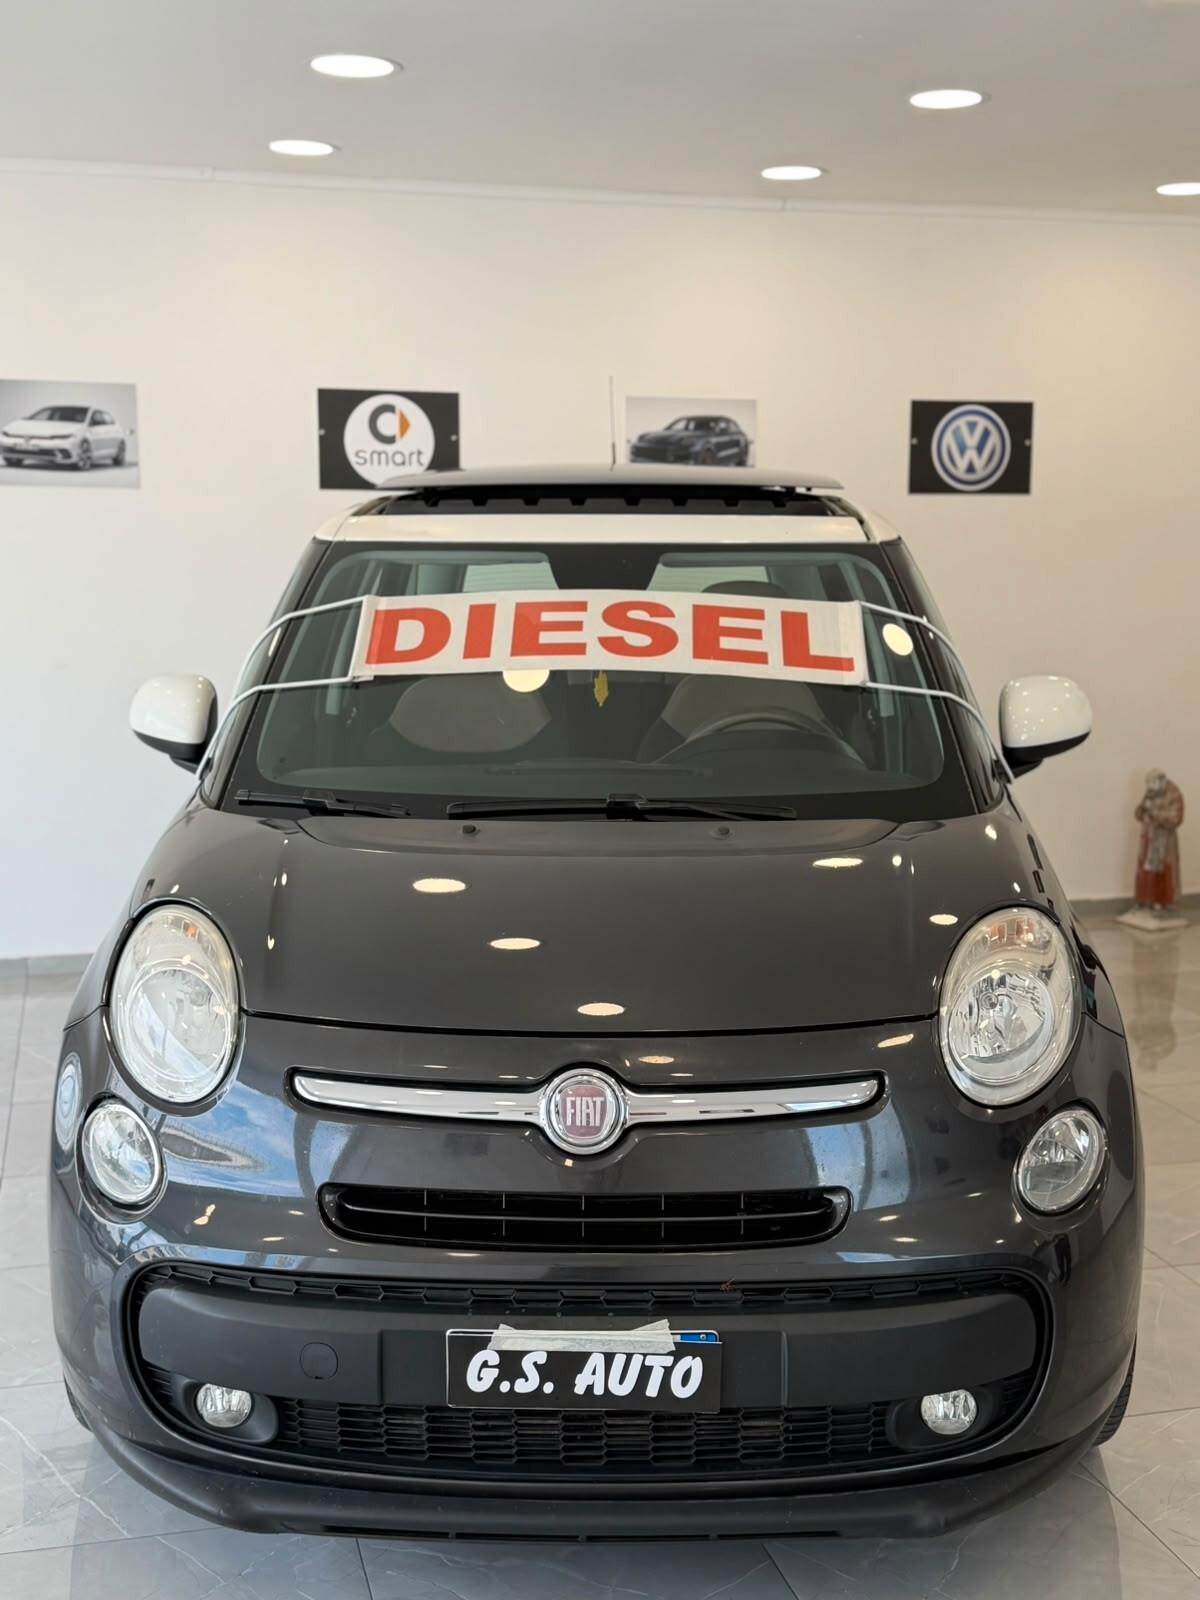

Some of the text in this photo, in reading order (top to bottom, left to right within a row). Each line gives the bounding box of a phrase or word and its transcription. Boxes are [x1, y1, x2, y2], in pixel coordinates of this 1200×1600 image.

[355, 448, 424, 467] smart
[366, 601, 853, 672] DIESEL
[566, 1097, 604, 1126] FIAT
[466, 1350, 704, 1398] G.S. AUTO
